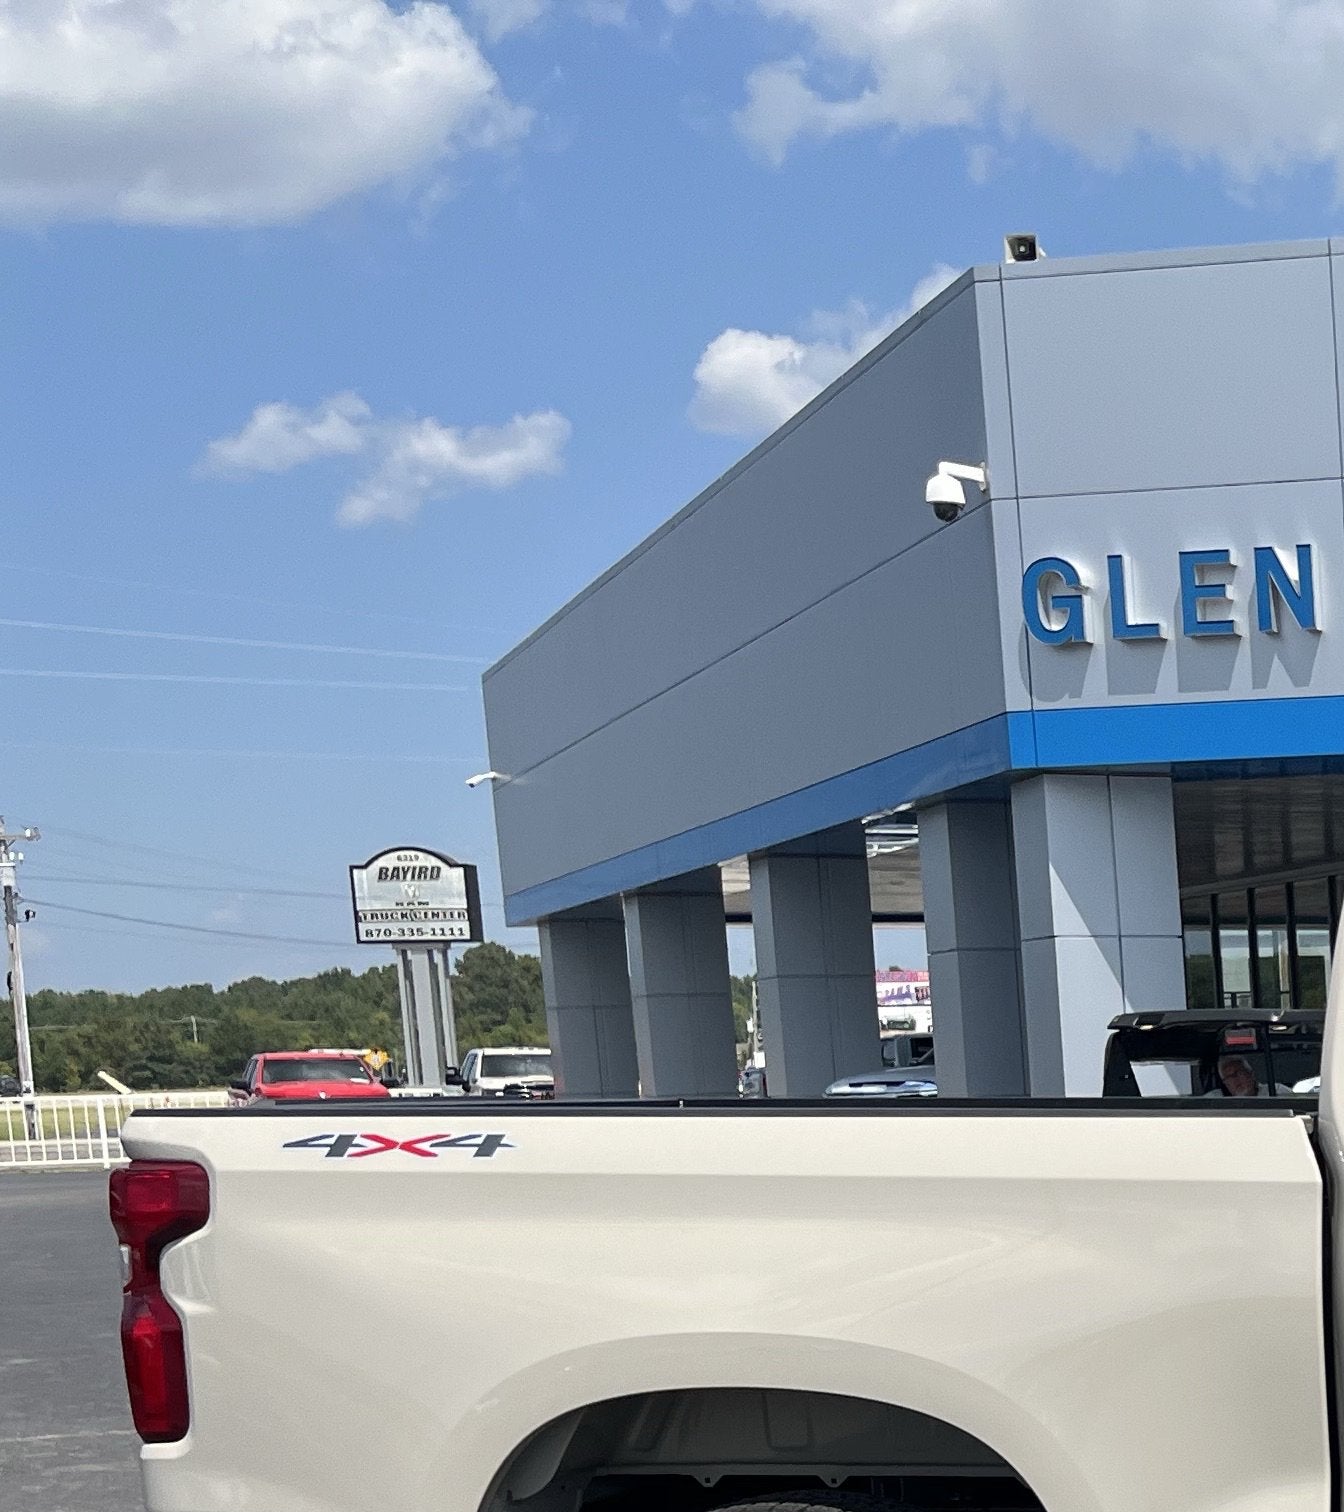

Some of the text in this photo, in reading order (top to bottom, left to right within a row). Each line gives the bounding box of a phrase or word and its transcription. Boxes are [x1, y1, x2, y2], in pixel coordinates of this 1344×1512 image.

[1021, 543, 1322, 646] GLEN
[377, 865, 441, 882] BAYIRD
[365, 927, 466, 938] 870-335-1111
